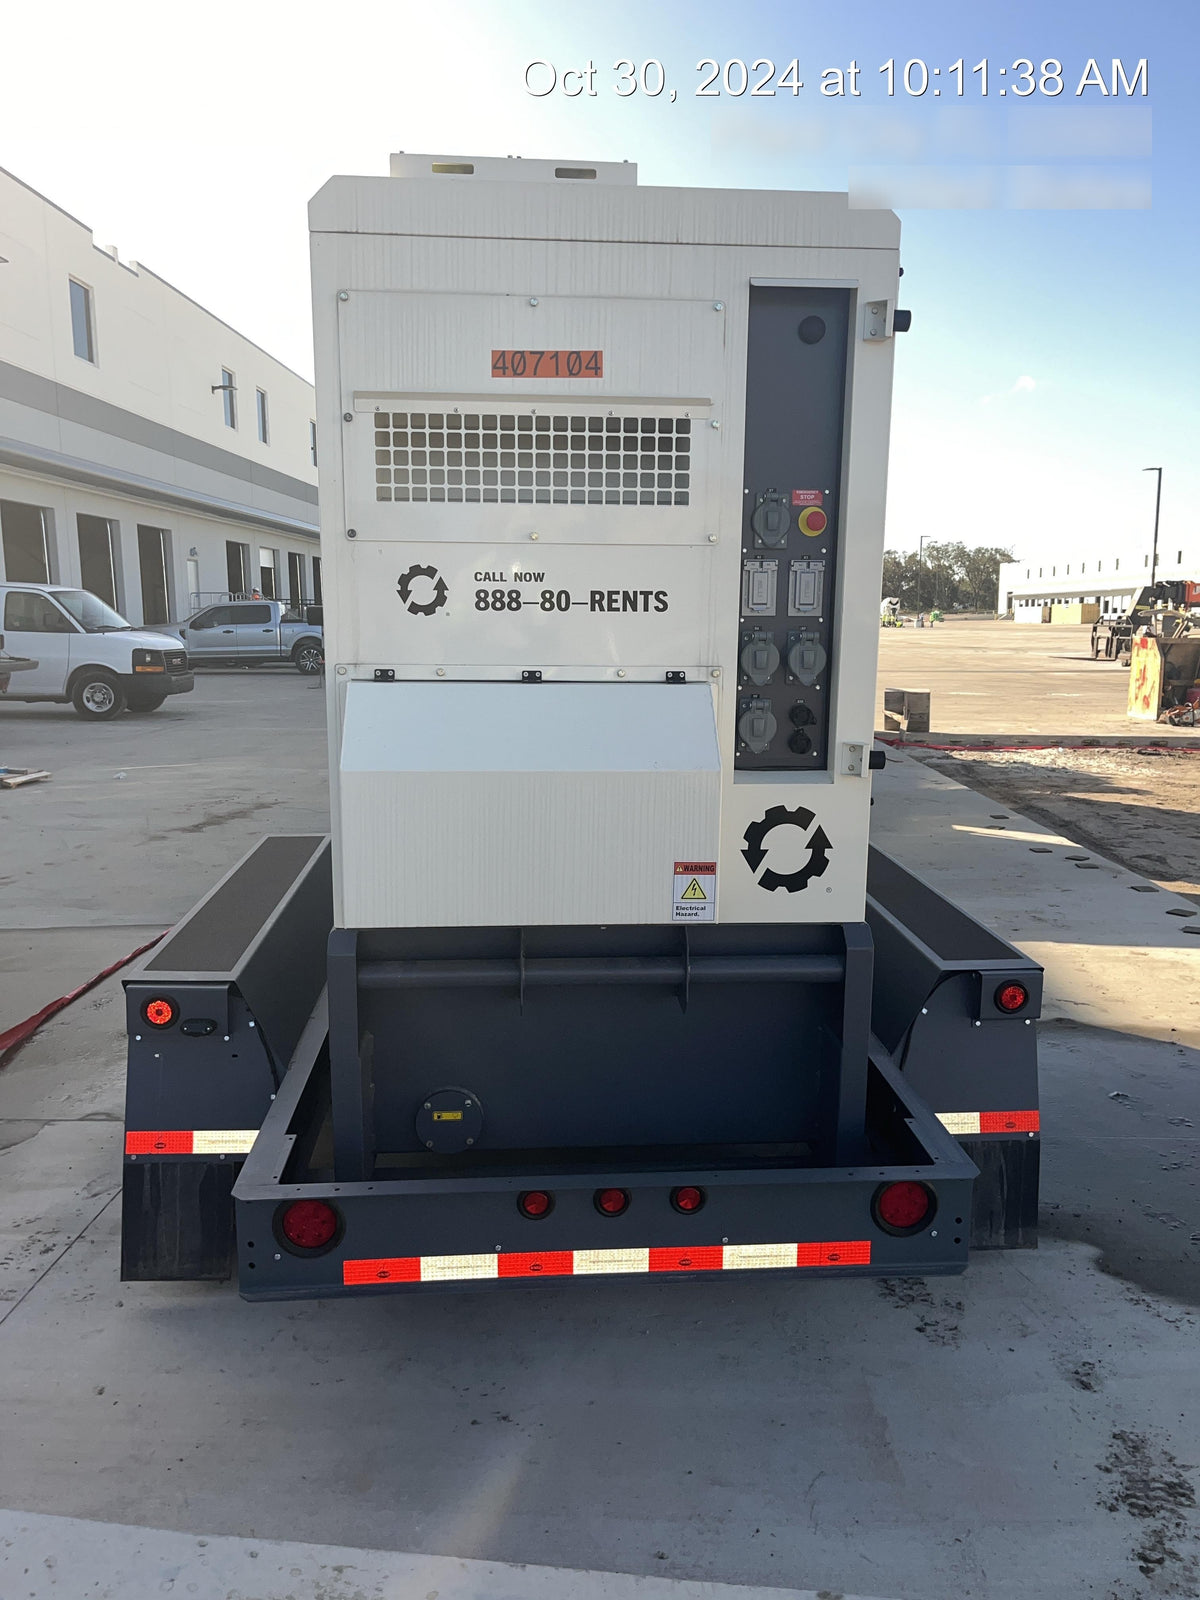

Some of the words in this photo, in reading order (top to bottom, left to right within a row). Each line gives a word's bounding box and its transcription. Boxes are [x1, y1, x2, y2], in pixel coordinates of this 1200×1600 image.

[491, 351, 602, 377] 407104
[474, 572, 507, 582] CALL
[514, 572, 546, 583] NOW
[474, 589, 669, 613] 888-80-RENTS
[683, 864, 715, 872] WARNING
